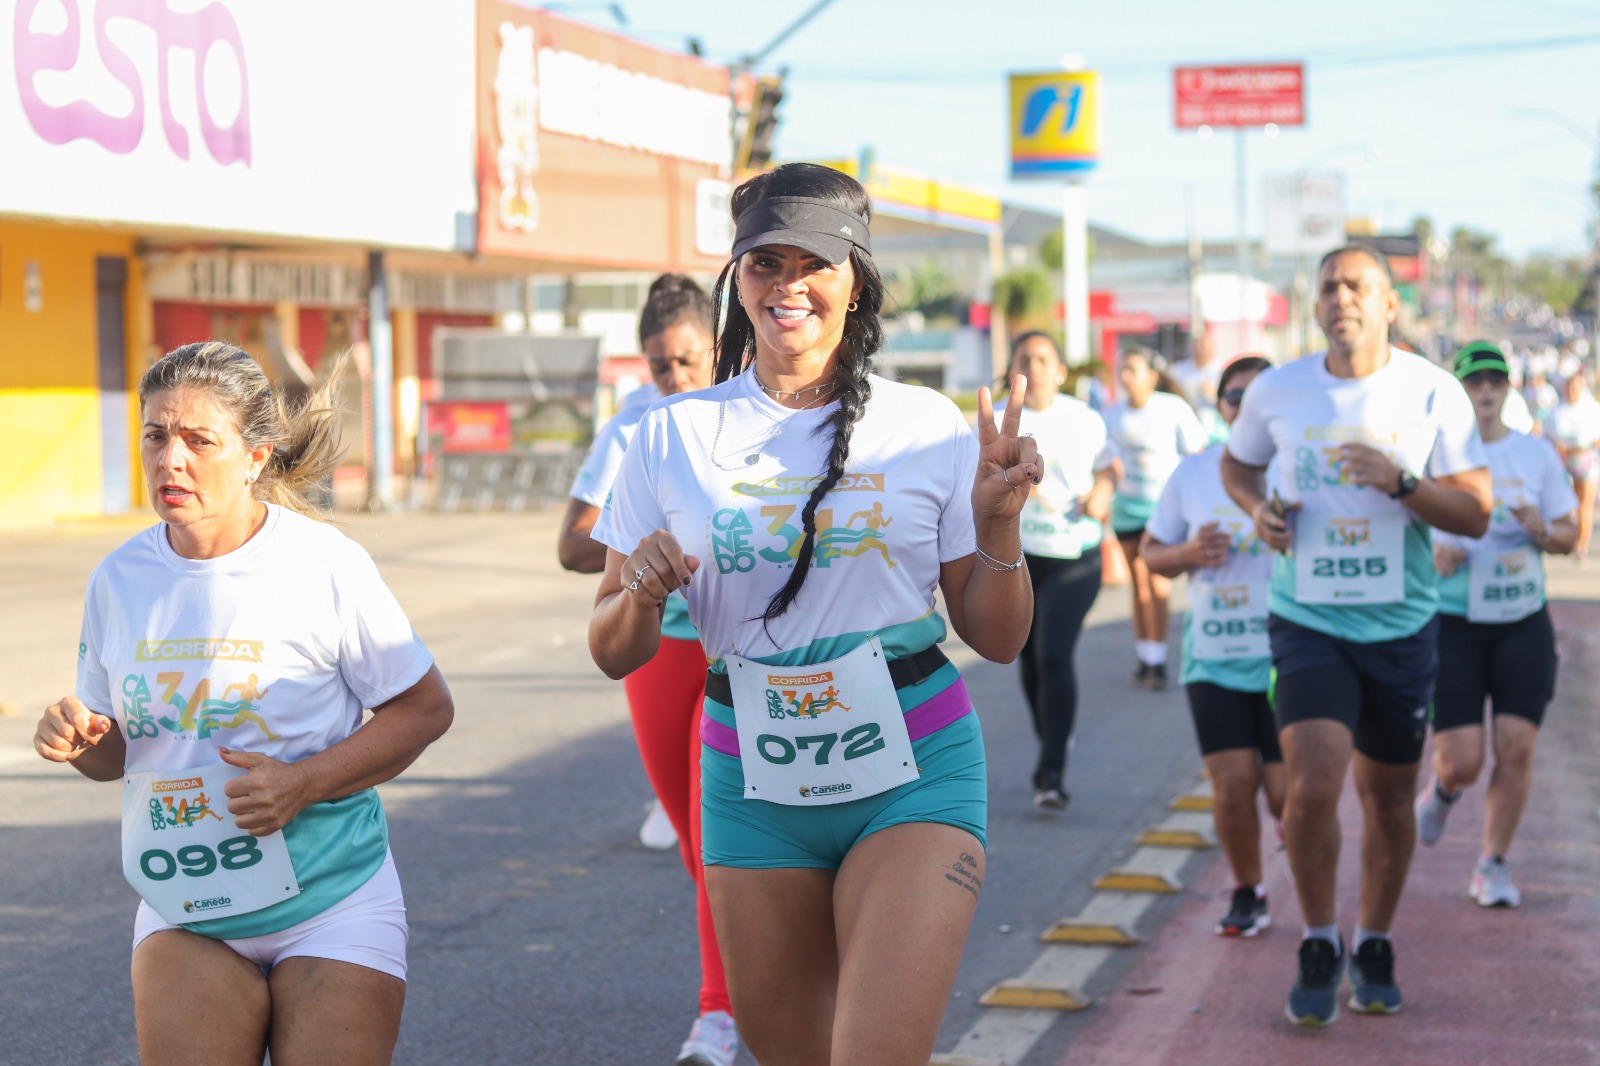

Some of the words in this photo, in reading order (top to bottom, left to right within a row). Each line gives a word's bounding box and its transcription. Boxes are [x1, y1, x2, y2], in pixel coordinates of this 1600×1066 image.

[1312, 556, 1387, 577] 255
[142, 641, 254, 658] CORRIDA
[771, 674, 829, 685] CORRIDA
[757, 722, 885, 766] 072
[154, 780, 200, 792] CORRIDA
[811, 782, 852, 795] Canedo
[140, 835, 263, 881] 098
[194, 896, 232, 909] Canedo
